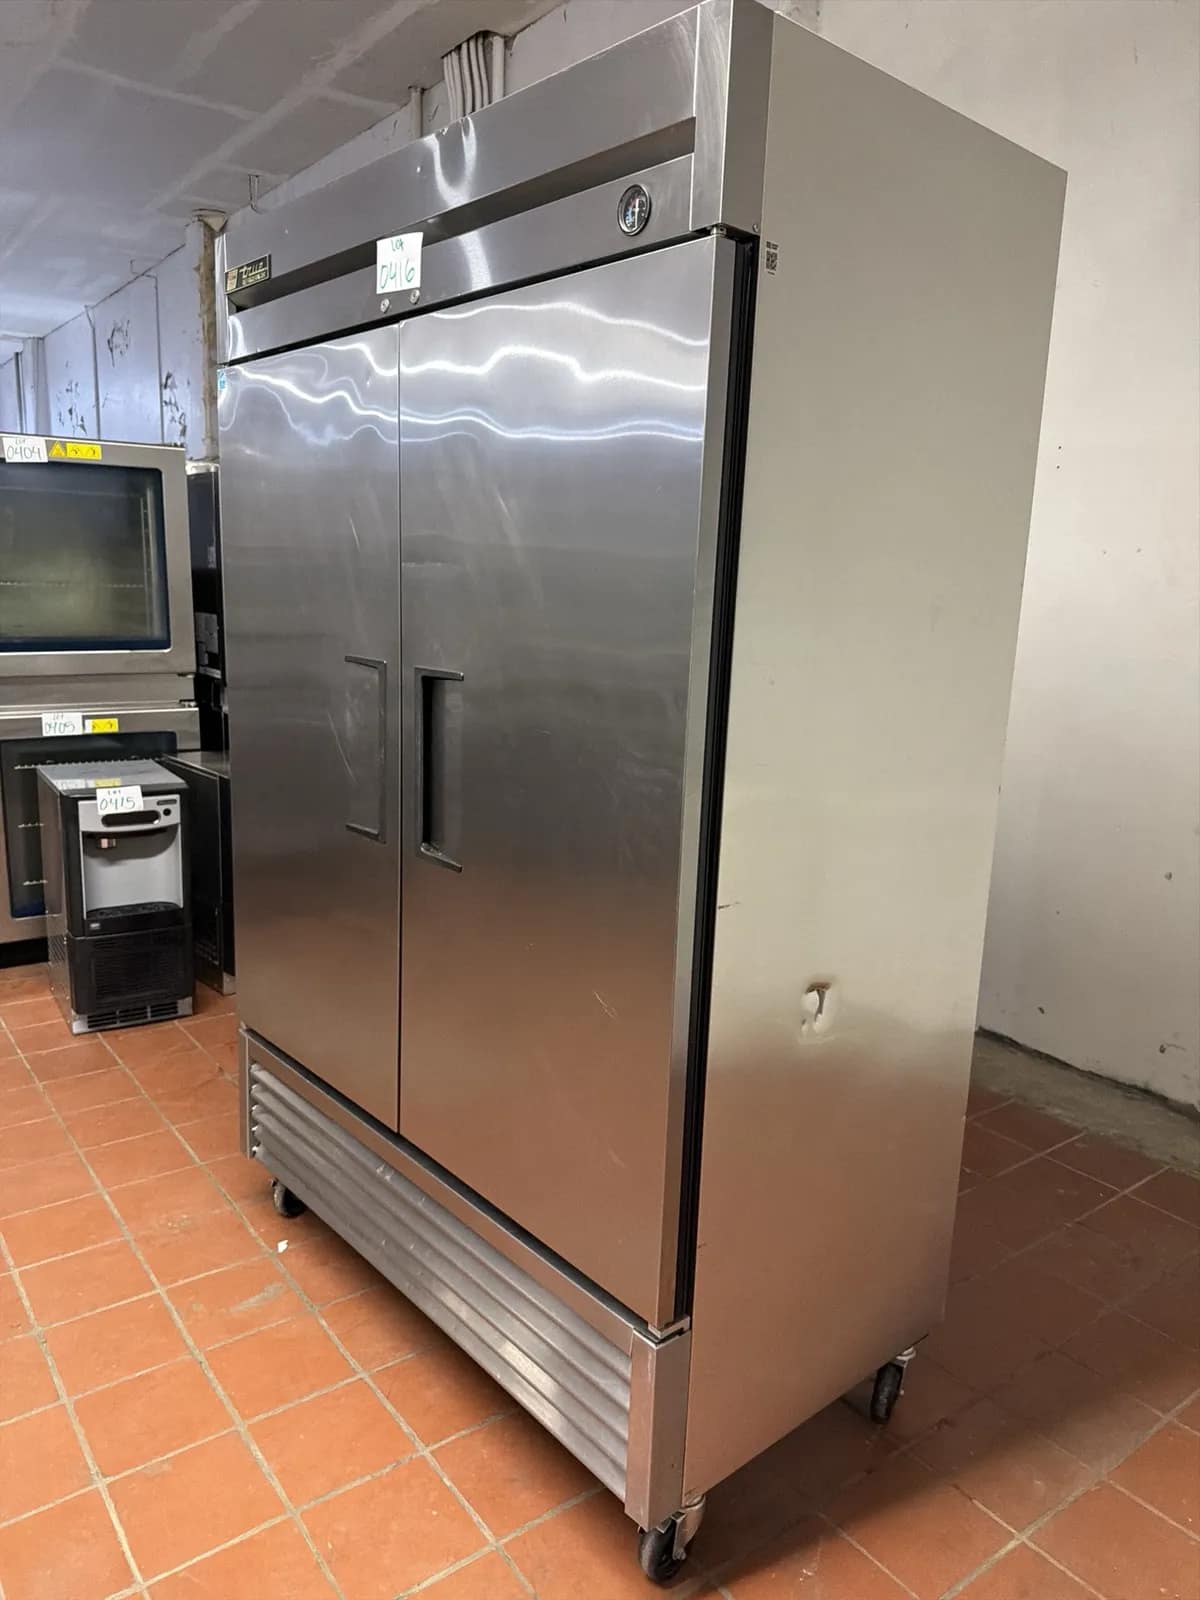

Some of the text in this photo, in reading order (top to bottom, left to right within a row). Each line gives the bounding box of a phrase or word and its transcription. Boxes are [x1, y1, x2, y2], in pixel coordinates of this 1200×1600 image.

[380, 258, 415, 289] 0416
[6, 445, 42, 460] 0404
[99, 797, 136, 811] 0415
